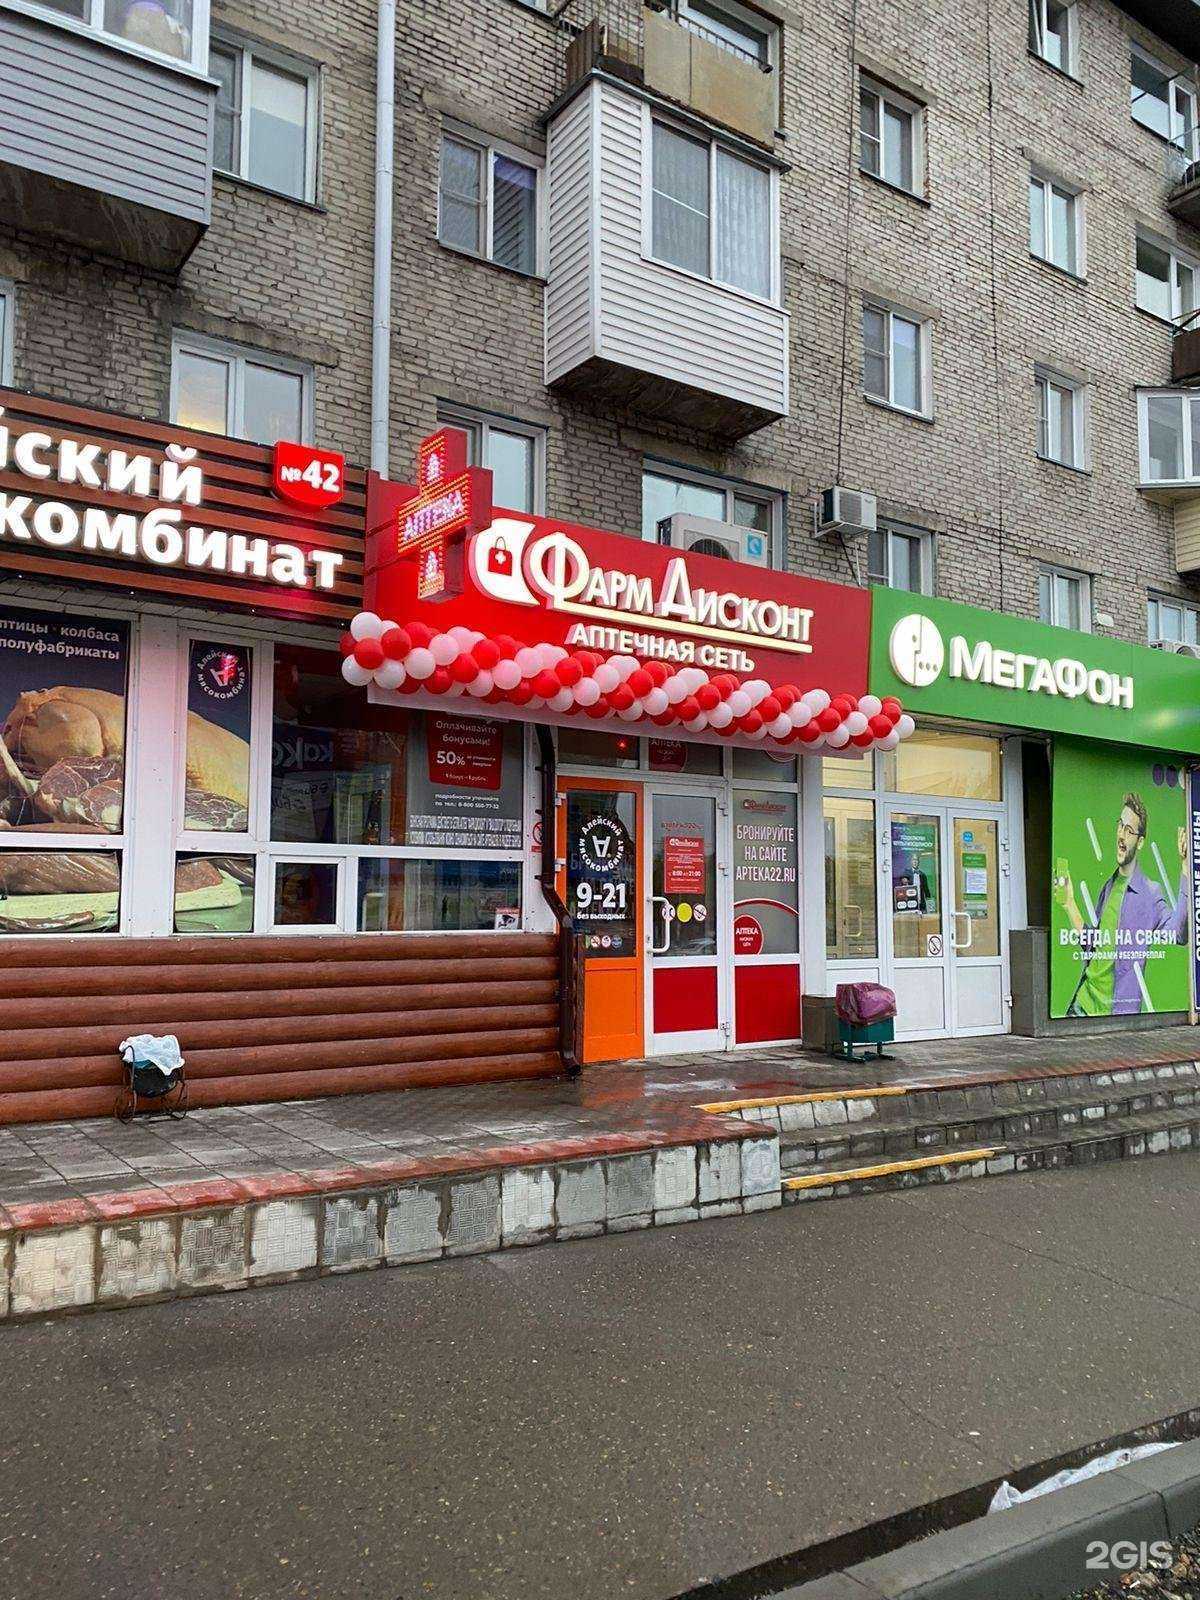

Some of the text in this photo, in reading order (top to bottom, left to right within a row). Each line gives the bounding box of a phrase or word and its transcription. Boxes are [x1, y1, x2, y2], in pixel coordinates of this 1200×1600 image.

[281, 459, 340, 493] №42
[404, 489, 463, 542] АПТЕКА
[0, 492, 343, 590] комбинат
[0, 620, 120, 642] птицы колбаса
[0, 638, 120, 659] полуфабрикаты
[565, 622, 755, 673] АПТЕЧНАЯ СЕТЬ
[436, 750, 466, 766] 50%
[581, 815, 623, 837] Алейский
[736, 823, 795, 842] БРОНИРУЙТЕ
[578, 838, 624, 872] мясокомбинат
[744, 844, 788, 862] НА САЙТЕ
[736, 866, 796, 882] APTEKA22.RU
[576, 882, 626, 908] 9-21
[576, 911, 590, 920] без
[736, 927, 759, 935] АПТЕКА
[1060, 928, 1177, 947] ВСЕГДА НА СВЯЗИ
